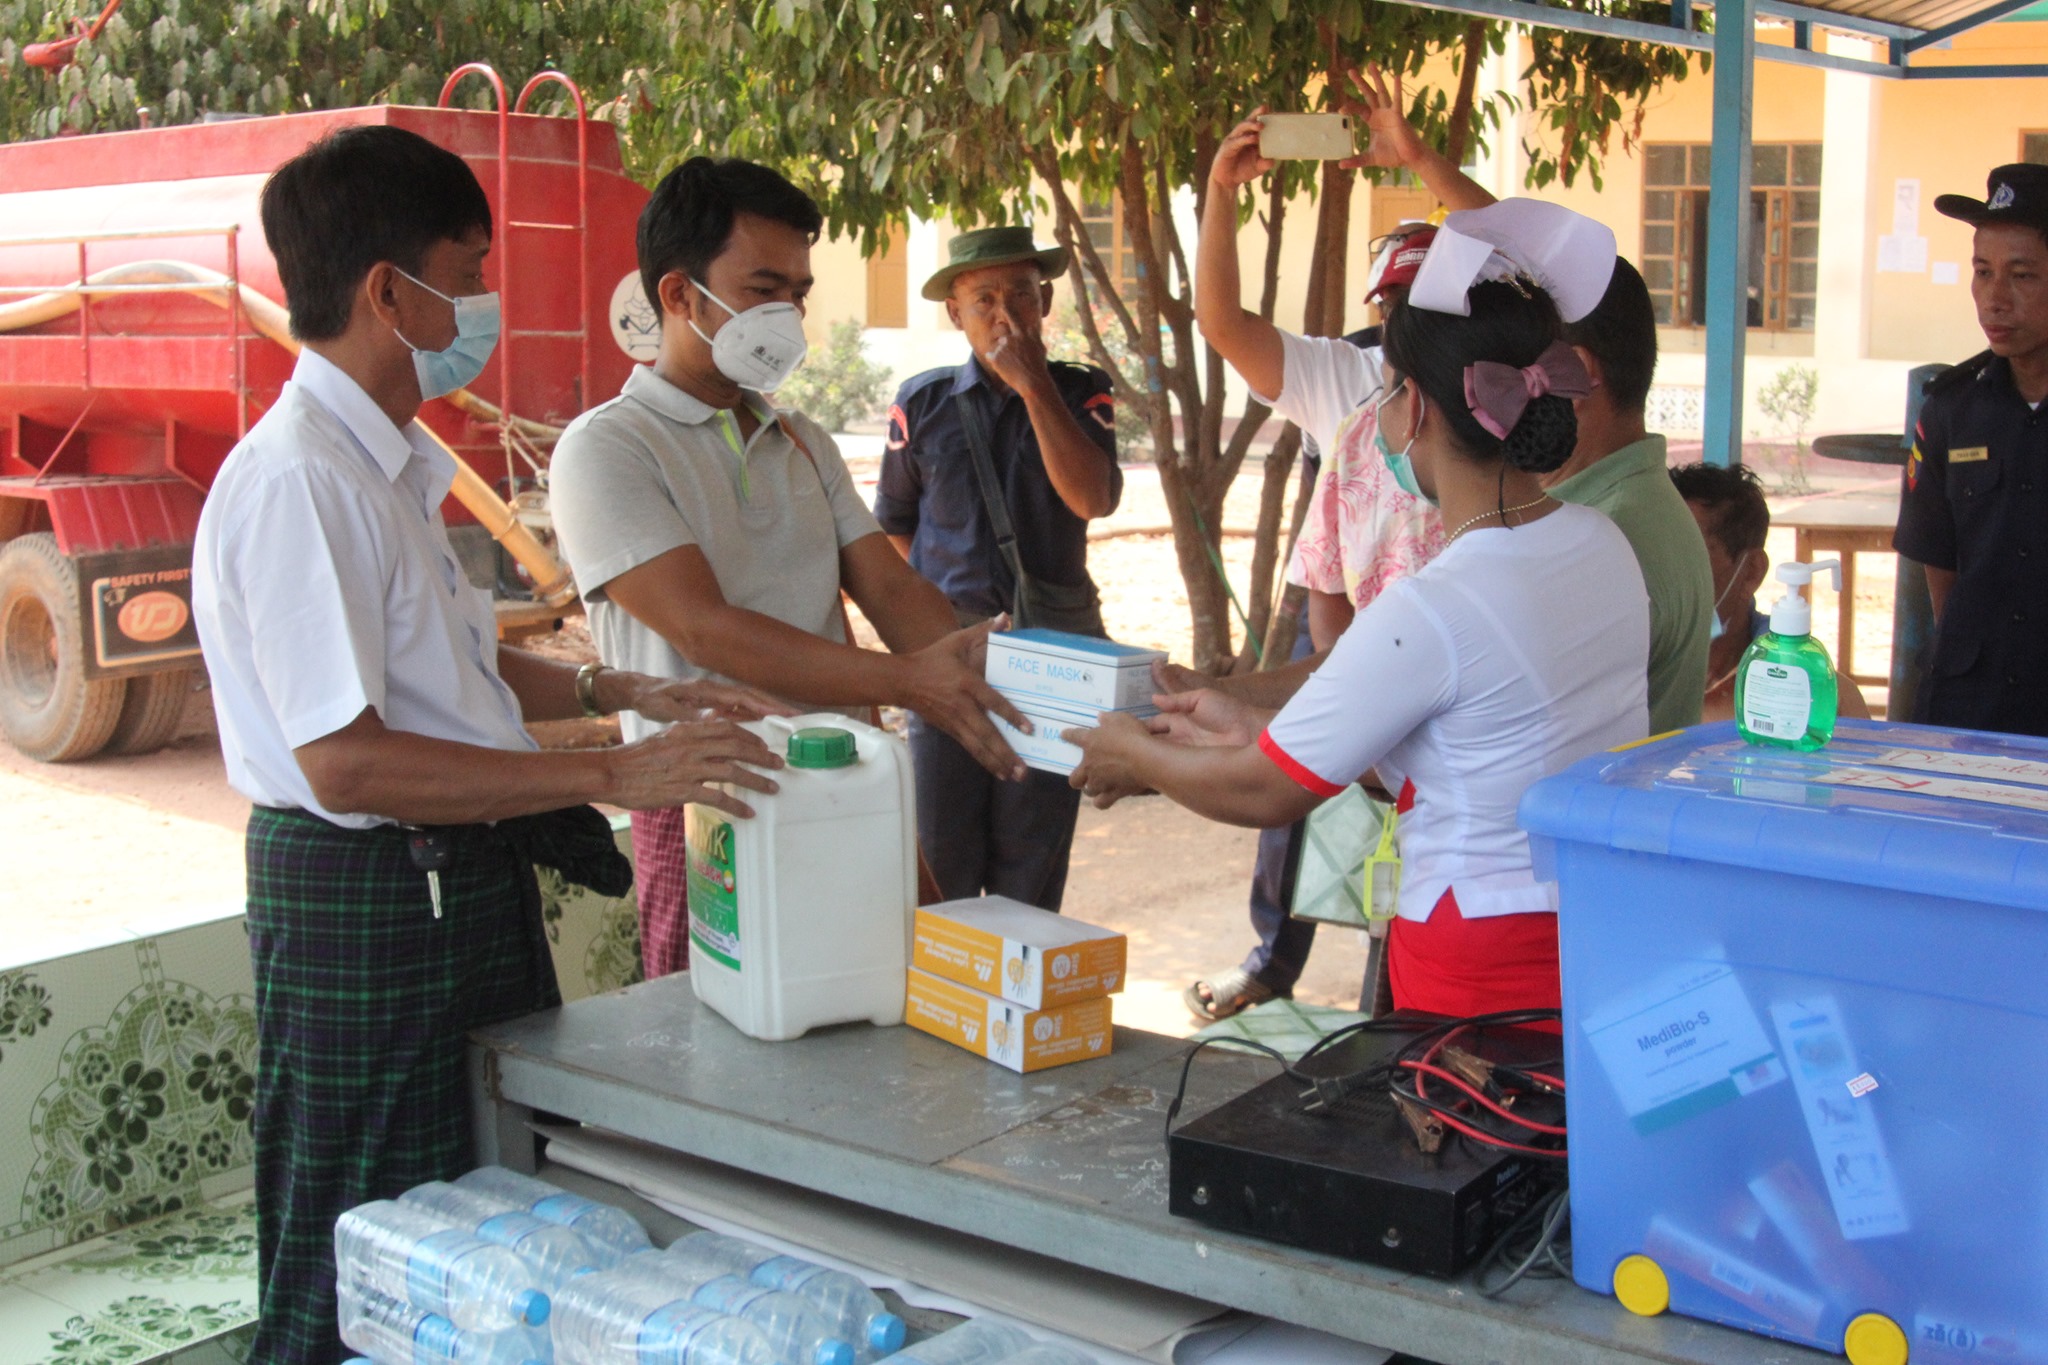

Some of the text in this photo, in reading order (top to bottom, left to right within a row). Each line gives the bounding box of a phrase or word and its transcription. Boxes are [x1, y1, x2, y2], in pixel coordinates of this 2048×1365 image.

[111, 569, 189, 588] SAFETY FIRST
[1008, 655, 1081, 682] FACE MASK
[1637, 1010, 1711, 1052] MediBio-S
[1664, 1035, 1698, 1057] powder
